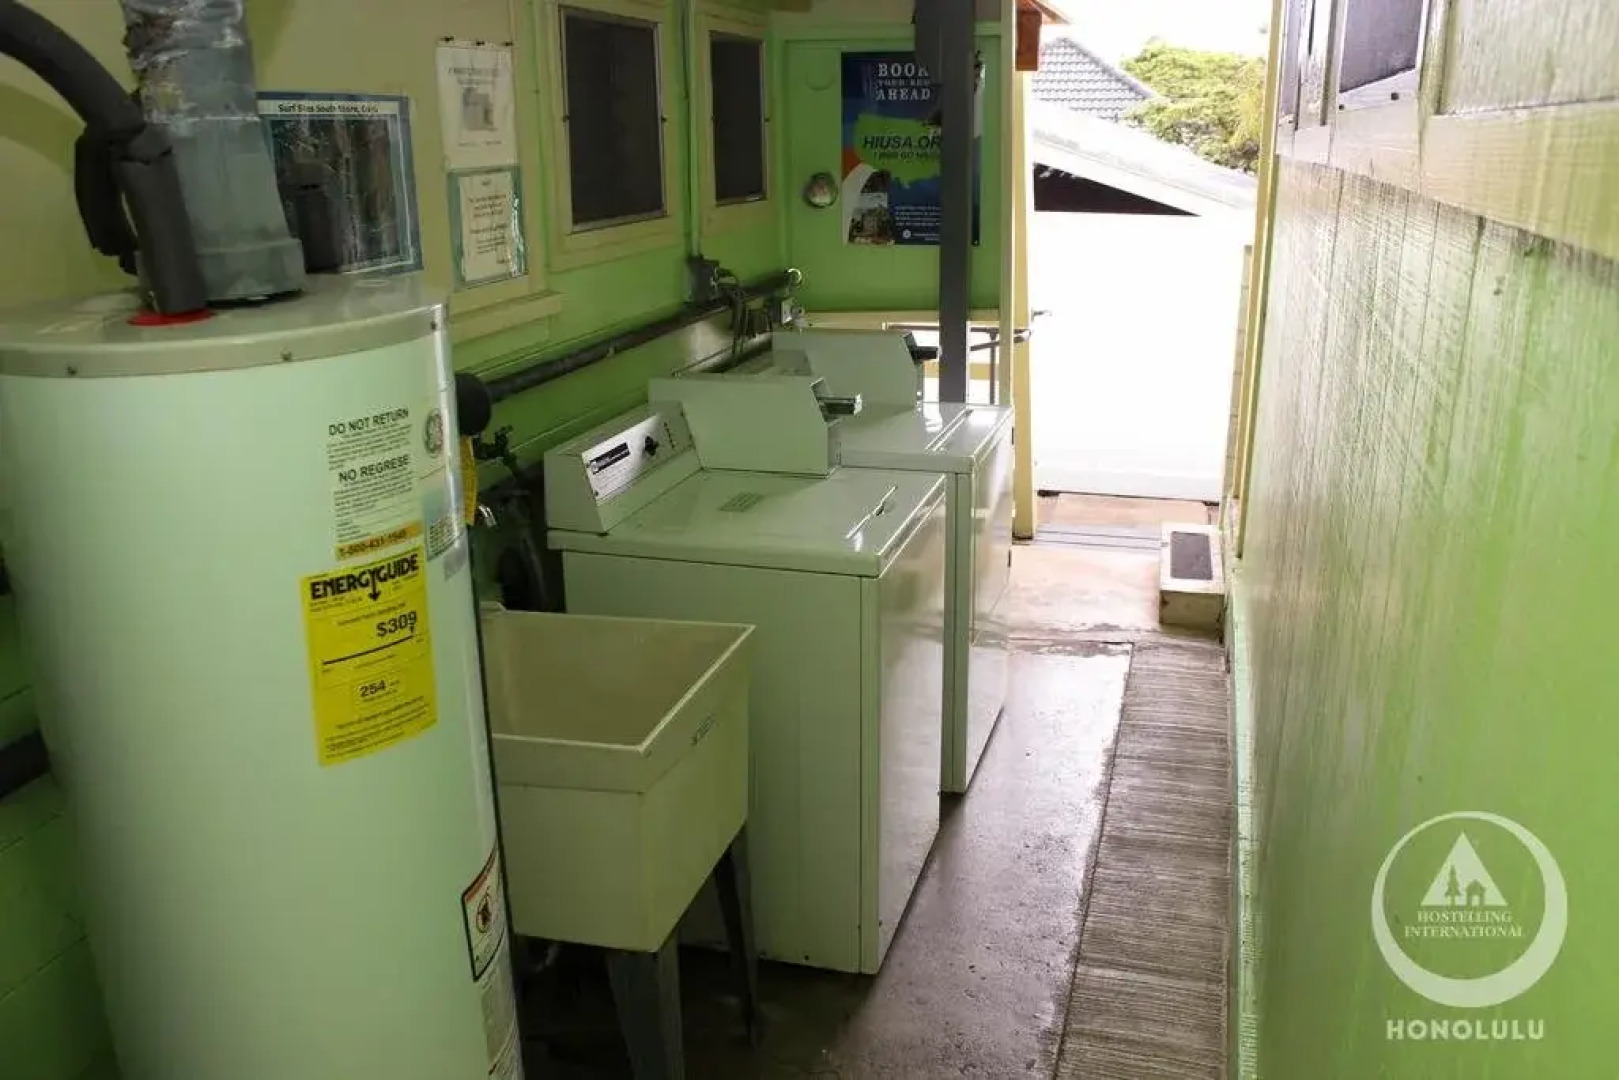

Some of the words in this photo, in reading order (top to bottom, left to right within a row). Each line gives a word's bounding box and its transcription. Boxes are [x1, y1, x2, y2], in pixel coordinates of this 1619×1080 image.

[875, 88, 931, 101] AHEAD
[864, 135, 941, 150] HIUSA.OR
[328, 423, 345, 436] DO
[349, 416, 369, 432] NOT
[372, 408, 409, 426] RETURN
[338, 469, 357, 482] NO
[360, 454, 410, 476] REGRESE
[359, 680, 386, 697] 254
